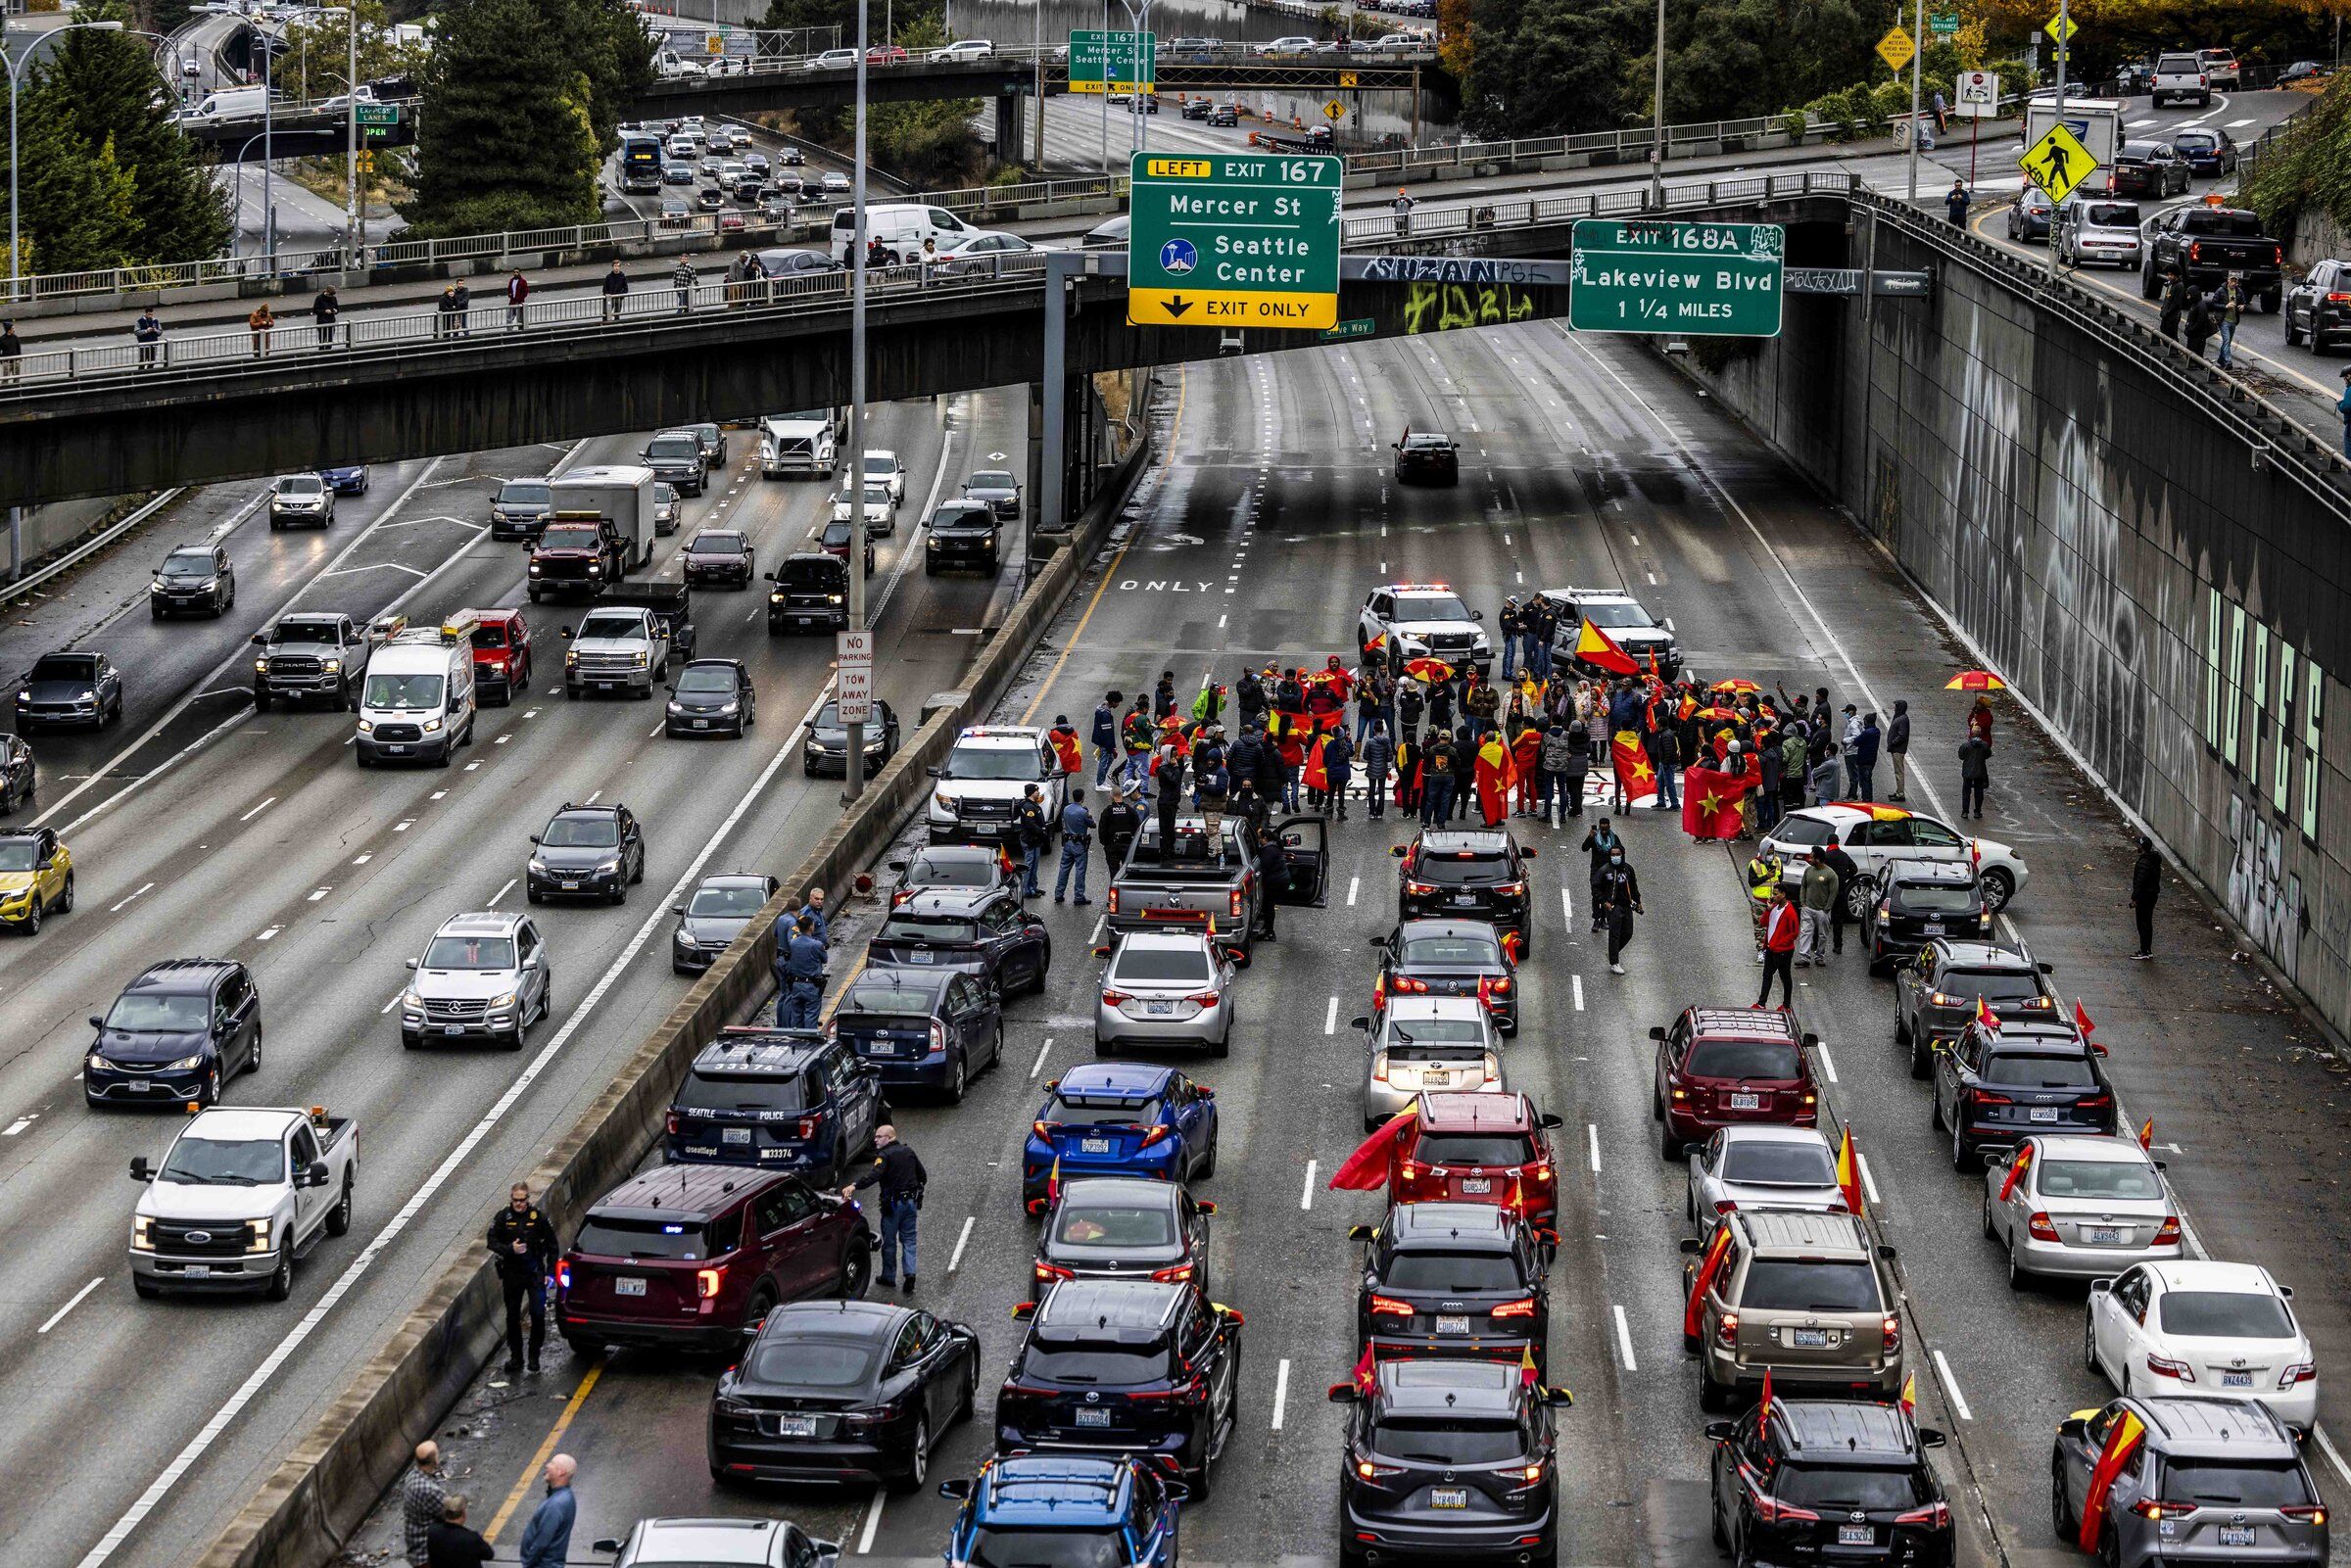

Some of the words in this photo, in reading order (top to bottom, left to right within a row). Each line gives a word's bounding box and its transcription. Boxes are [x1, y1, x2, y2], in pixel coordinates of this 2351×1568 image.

[1115, 33, 1134, 42] 167
[1087, 46, 1122, 55] Mercer
[1156, 162, 1203, 176] LEFT
[1225, 163, 1266, 177] EXIT
[1280, 162, 1324, 182] 167
[1171, 195, 1258, 215] Mercer
[1273, 197, 1301, 217] St
[1616, 230, 1660, 245] EXIT
[1672, 227, 1738, 250] 168A
[1215, 235, 1309, 257] Seattle
[1217, 261, 1306, 283] Center
[1582, 268, 1700, 290] Lakeview
[1716, 272, 1771, 291] Blvd
[1207, 302, 1247, 315] EXIT
[1259, 303, 1310, 317] ONLY
[1618, 300, 1626, 318] 1
[1678, 303, 1732, 318] MILES
[1351, 323, 1368, 334] Way
[1120, 580, 1214, 592] ONLY
[847, 638, 863, 649] NO
[839, 653, 872, 662] PARKING
[845, 675, 865, 685] TOW
[841, 689, 868, 700] AWAY
[841, 706, 864, 716] ZONE
[714, 1063, 773, 1071] 33374
[688, 1108, 716, 1118] SEATTLE
[759, 1111, 785, 1120] POLICE
[769, 1149, 792, 1159] 33374
[2222, 1374, 2252, 1386] BVZ4439
